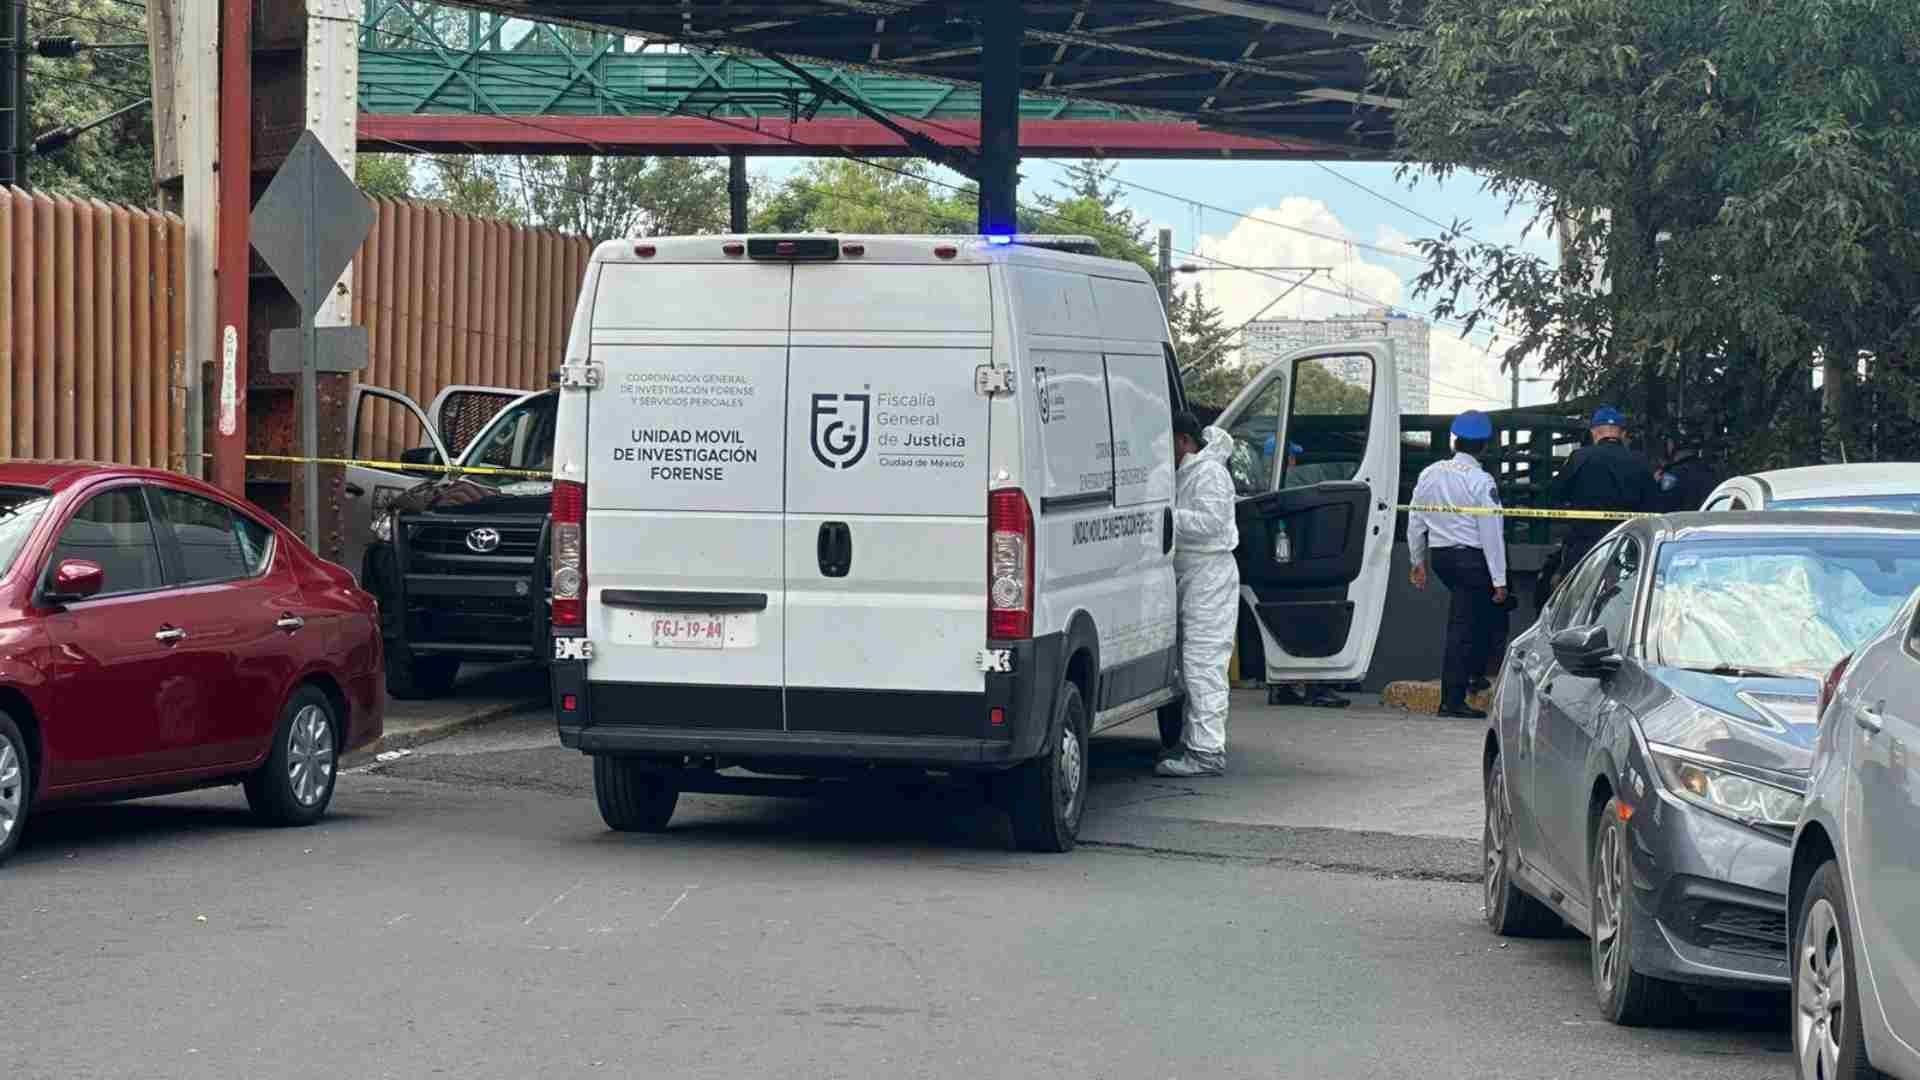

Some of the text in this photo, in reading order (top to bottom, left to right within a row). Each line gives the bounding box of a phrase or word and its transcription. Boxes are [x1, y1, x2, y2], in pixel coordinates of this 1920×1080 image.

[877, 412, 940, 426] General
[631, 429, 692, 443] UNIDAD
[878, 432, 965, 447] de Justicia
[613, 446, 757, 462] DE INVESTIGACIÓN
[879, 457, 913, 466] Ciudad
[915, 458, 928, 466] de
[650, 467, 724, 480] FORENSE
